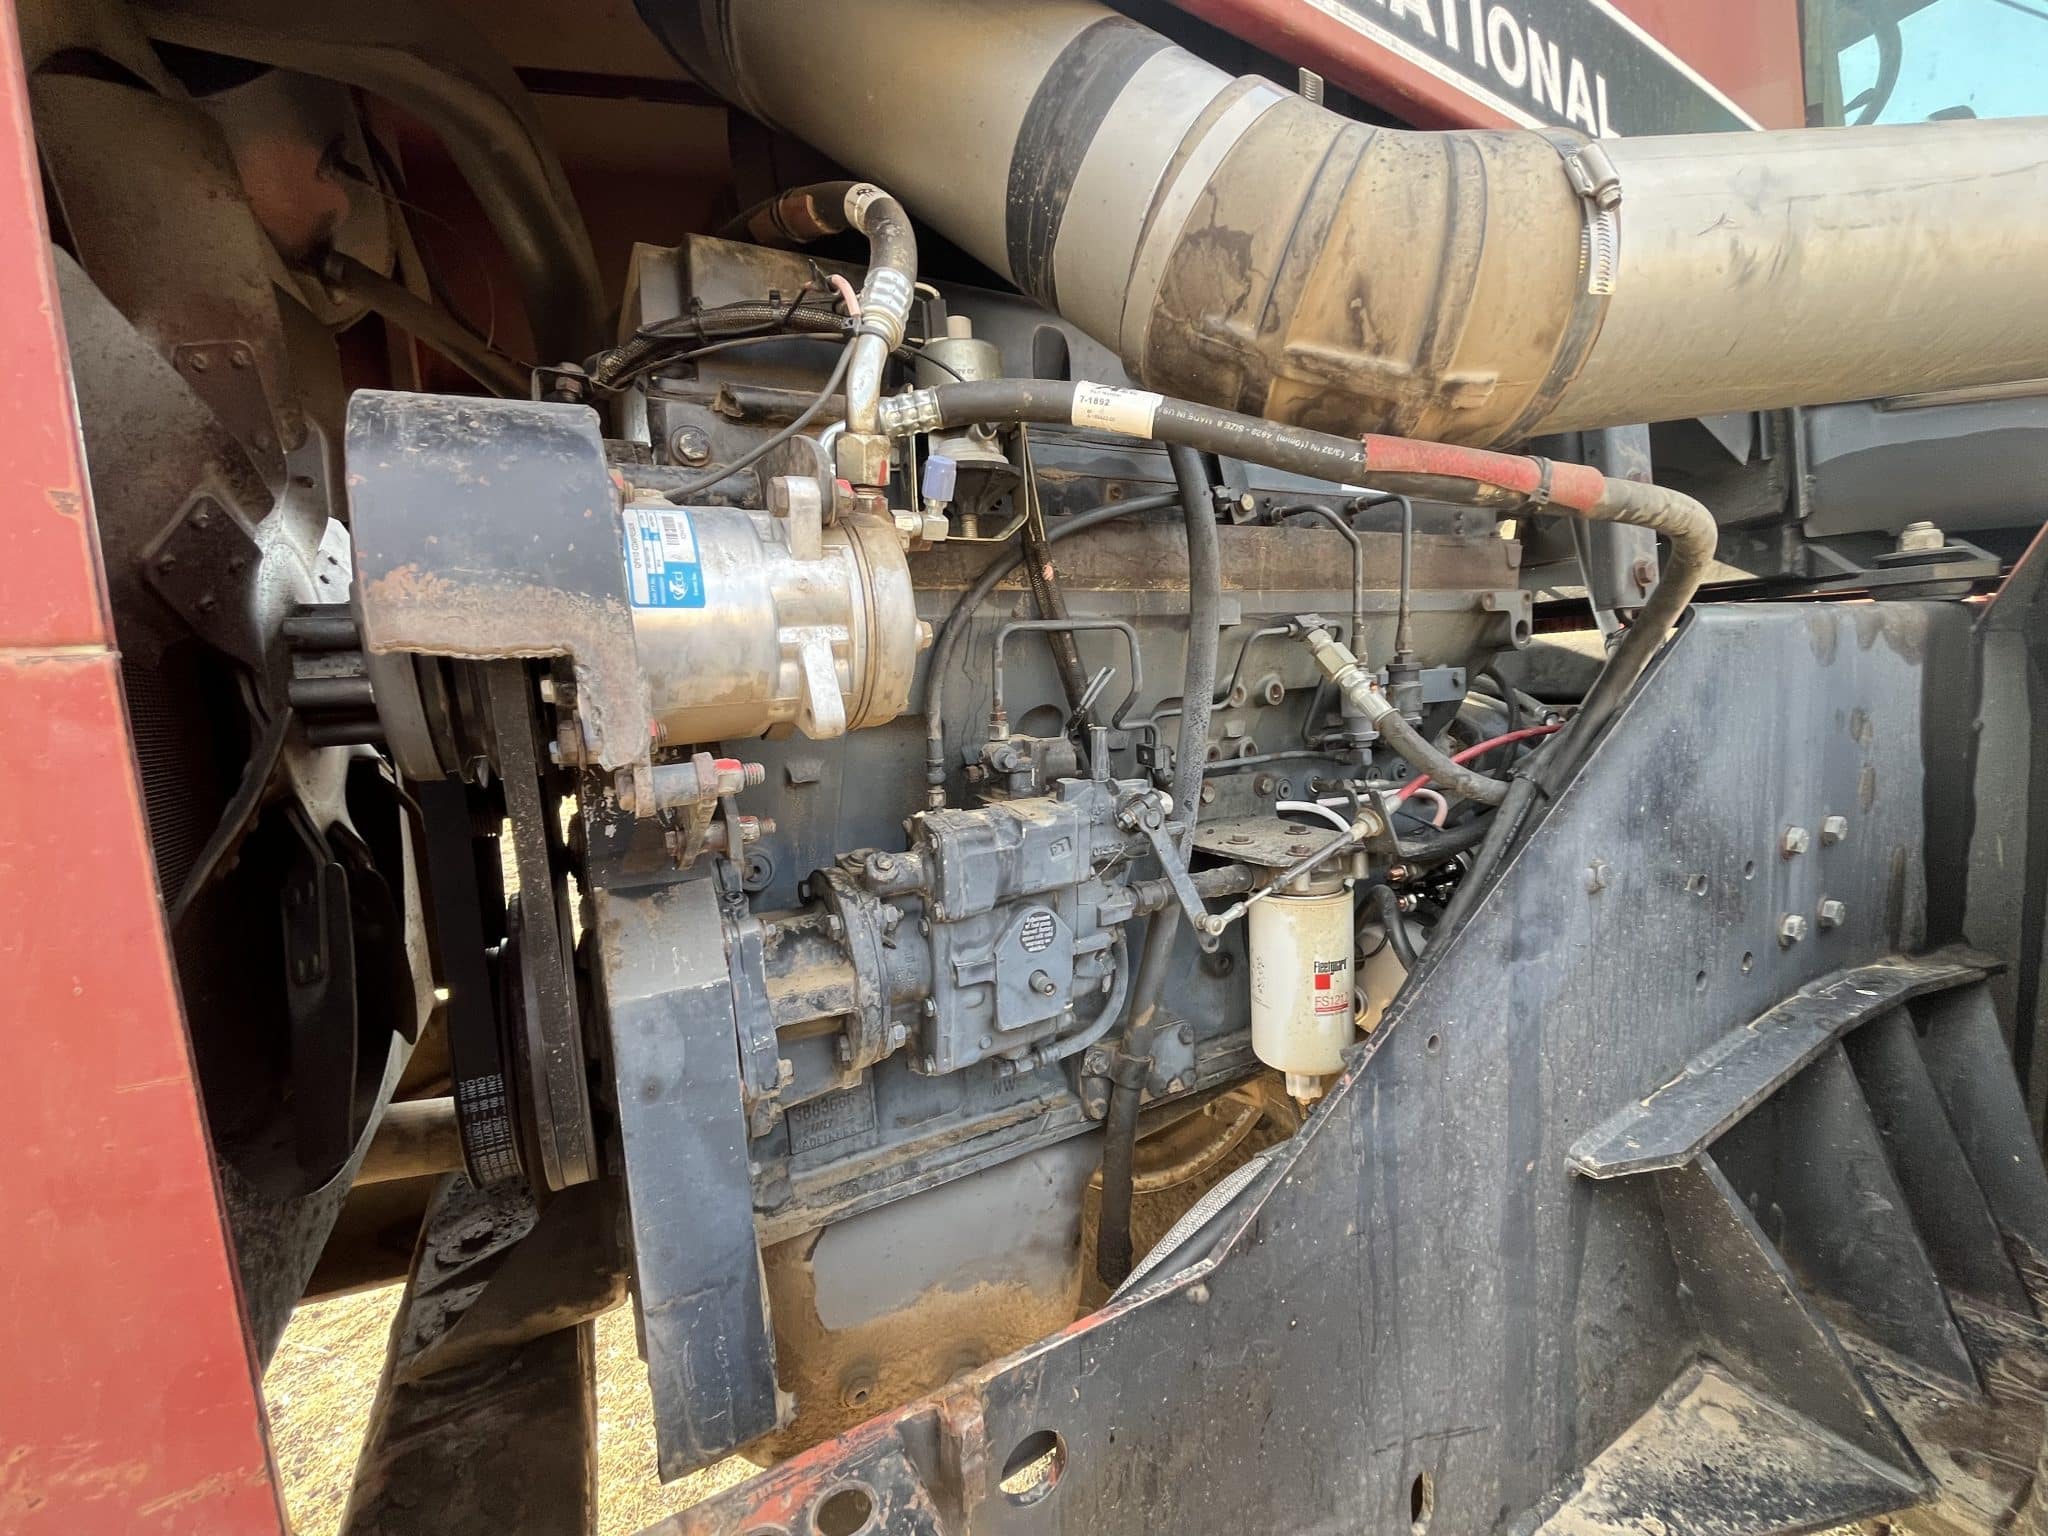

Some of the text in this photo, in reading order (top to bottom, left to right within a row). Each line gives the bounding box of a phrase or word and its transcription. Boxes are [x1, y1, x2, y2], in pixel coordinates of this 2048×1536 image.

[1176, 409, 1186, 419] IN
[1186, 412, 1213, 425] MADE
[1223, 421, 1245, 433] SIZE
[1313, 958, 1347, 975] Fleetguard
[465, 1080, 477, 1099] CNH
[475, 1077, 488, 1098] CNH
[486, 1074, 499, 1095] CNH
